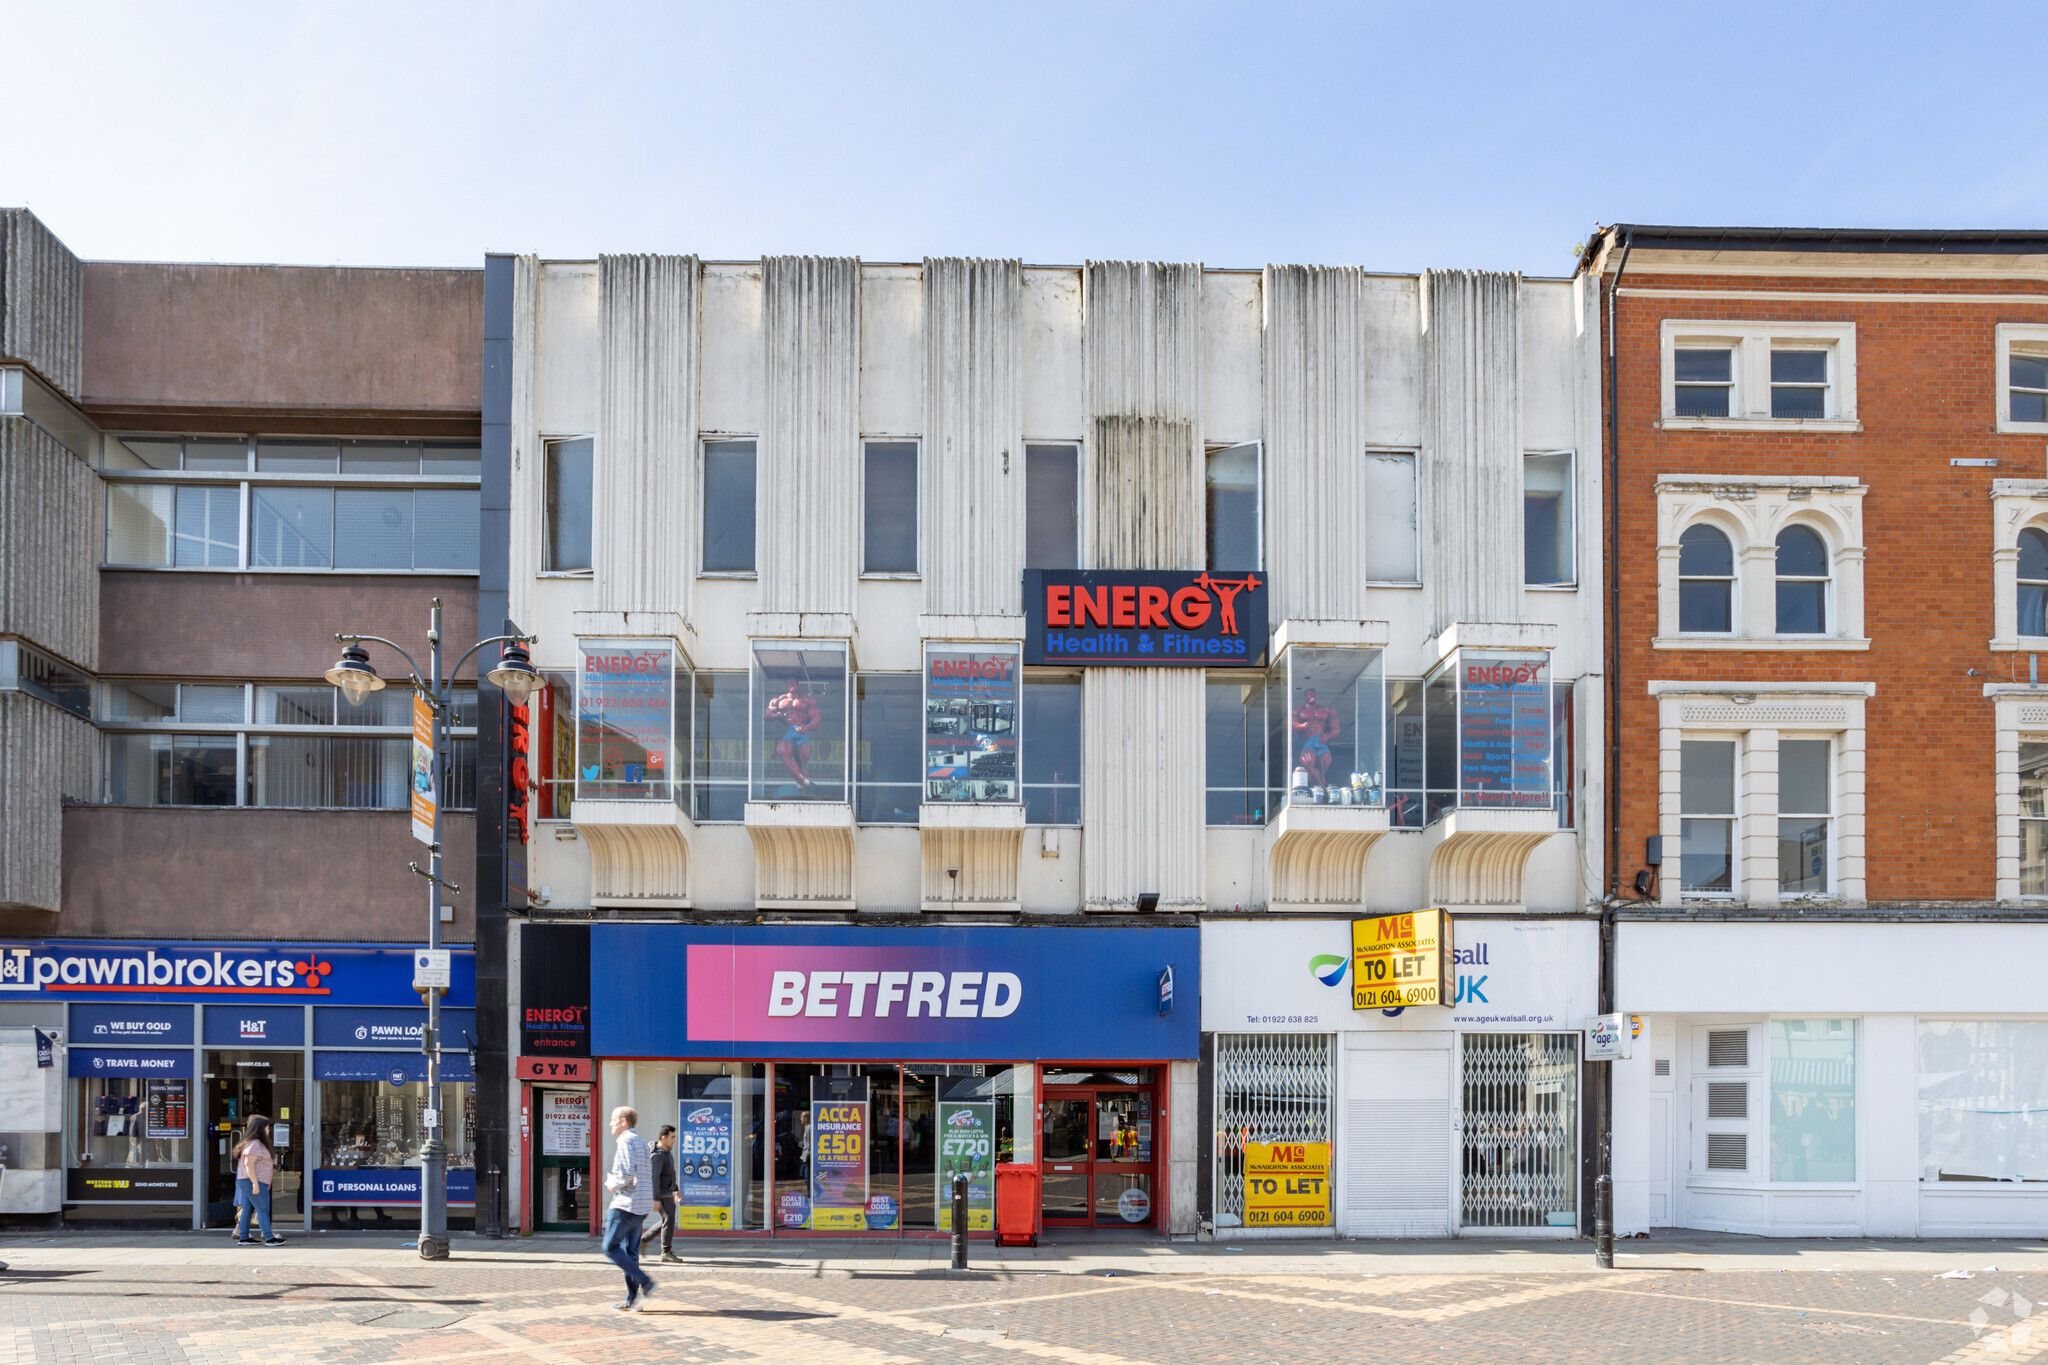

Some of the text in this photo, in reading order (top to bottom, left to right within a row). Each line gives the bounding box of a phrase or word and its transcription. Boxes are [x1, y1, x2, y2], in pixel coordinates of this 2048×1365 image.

[1047, 574, 1255, 634] ENERGY
[1047, 633, 1246, 654] Health & Fitness
[585, 653, 667, 674] ENERGY
[932, 658, 1014, 680] ENERGY
[585, 674, 663, 682] Health & Fitness
[1468, 662, 1546, 685] ENERGY
[932, 677, 964, 686] Health
[978, 678, 1011, 687] Fitness
[1468, 684, 1543, 692] Health & Fitness
[581, 697, 668, 708] 01922 624 466
[1502, 729, 1519, 738] Only
[1486, 753, 1509, 761] Sports
[1481, 765, 1509, 773] Weights
[1464, 792, 1549, 802] & Much More!!
[1397, 938, 1436, 948] ASSOCIATES
[1454, 943, 1489, 965] sall
[33, 951, 295, 990] pawnbrokers
[1364, 959, 1386, 980] TO
[1393, 956, 1425, 978] LET
[768, 971, 1022, 1018] BETFRED
[1357, 987, 1436, 1006] 0121 604 6900
[526, 1006, 586, 1023] ENERGY
[1454, 1015, 1554, 1023] www.ageukwalsall.org.uk
[240, 1020, 267, 1032] H&T
[372, 1026, 423, 1035] PAWN LOA
[534, 1038, 576, 1047] entrance
[106, 1059, 175, 1068] TRAVEL MONEY
[532, 1063, 577, 1075] GYM
[555, 1096, 588, 1105] ENERGY
[818, 1108, 861, 1122] ACCA
[956, 1117, 982, 1126] LOTTO
[682, 1136, 729, 1154] £820
[818, 1134, 861, 1154] £50
[943, 1139, 989, 1155] £720
[1250, 1179, 1323, 1194] TO LET
[1249, 1211, 1325, 1222] 0121 604 6900
